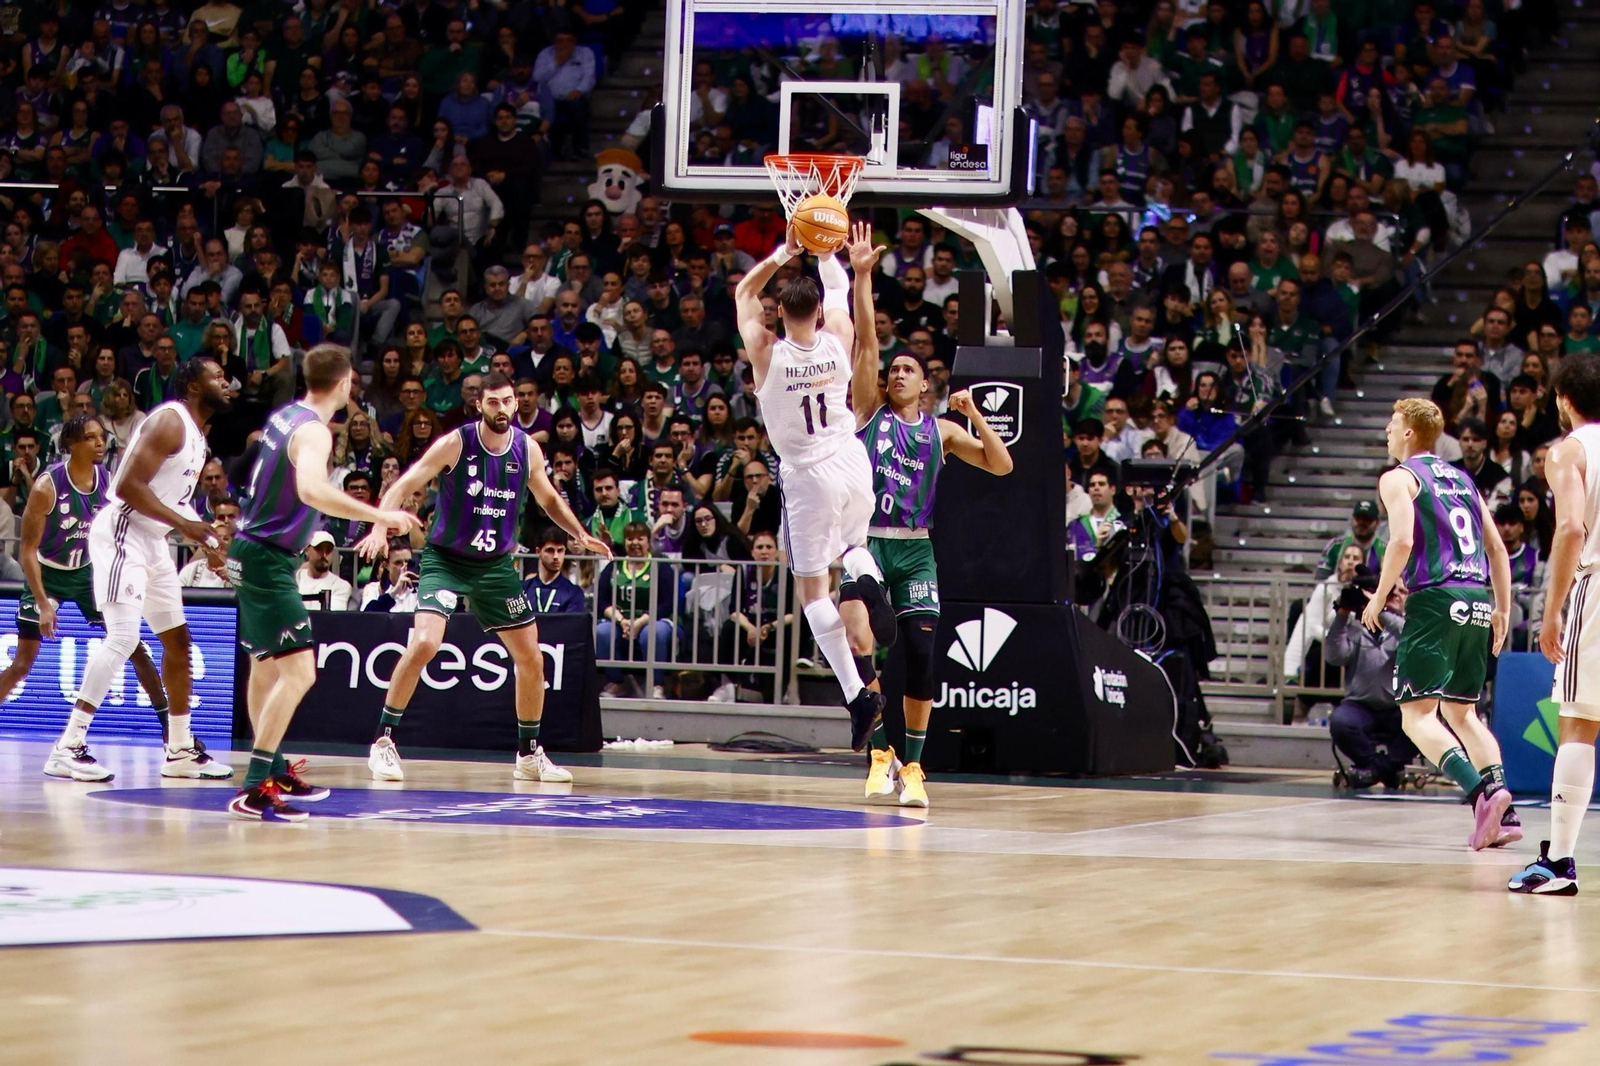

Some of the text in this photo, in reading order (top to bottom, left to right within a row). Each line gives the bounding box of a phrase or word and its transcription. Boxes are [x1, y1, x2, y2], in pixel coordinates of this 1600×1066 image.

[950, 151, 967, 161] liga
[950, 160, 986, 169] endesa
[813, 211, 847, 229] Wilson
[785, 360, 837, 379] HEZONJA
[785, 376, 835, 392] AUTOHERO
[799, 392, 828, 435] 11
[876, 465, 912, 487] málaga
[483, 486, 516, 502] Unicaja
[880, 493, 894, 515] 0
[473, 503, 507, 519] málaga
[471, 529, 497, 553] 45
[1449, 507, 1477, 556] 9
[68, 548, 84, 568] 11
[316, 627, 565, 692] ndesa
[932, 681, 1037, 716] Unicaja
